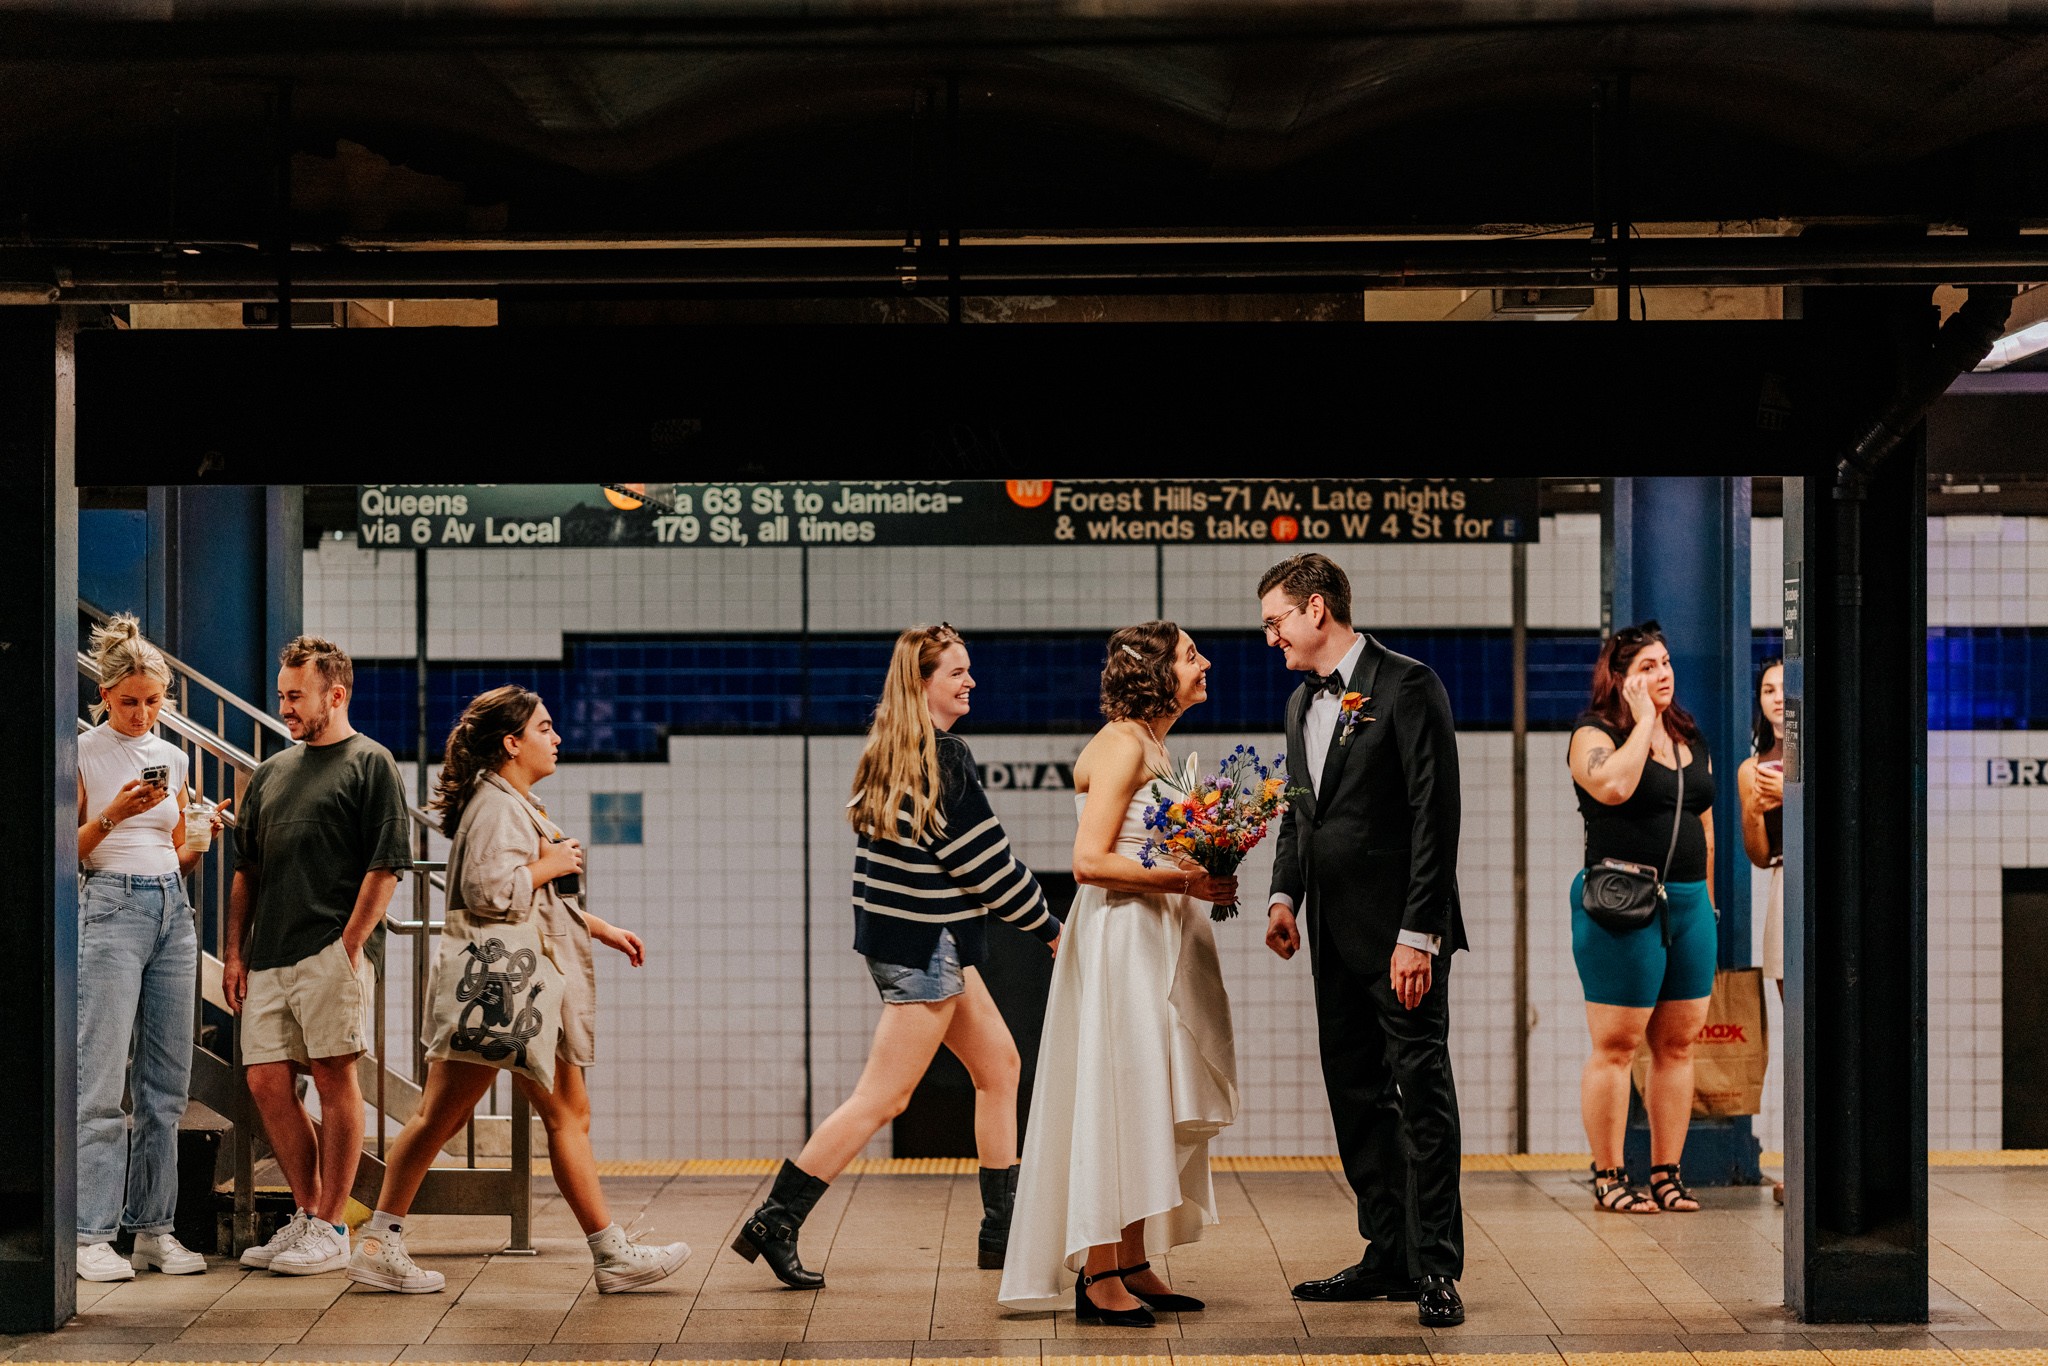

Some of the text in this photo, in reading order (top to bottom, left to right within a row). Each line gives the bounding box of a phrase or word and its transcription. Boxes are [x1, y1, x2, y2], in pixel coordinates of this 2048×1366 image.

[361, 488, 468, 516] Queens
[702, 487, 742, 514] 63
[751, 487, 784, 514] St
[792, 487, 824, 514] to
[1054, 487, 1143, 512] Forest
[1261, 486, 1302, 511] Av.
[1312, 485, 1373, 511] Late
[1383, 485, 1466, 517] nights
[361, 516, 561, 543] via 6 Av Local
[651, 514, 876, 547] 179 St, all times
[1054, 514, 1075, 540] &
[1087, 514, 1195, 540] wkends
[1206, 514, 1268, 539] take
[1301, 516, 1330, 539] to
[1341, 514, 1370, 538] W
[1380, 513, 1400, 538] 4
[1411, 514, 1442, 539] St
[1454, 513, 1493, 538] for
[985, 763, 1073, 789] DWA
[1989, 759, 2048, 786] BR
